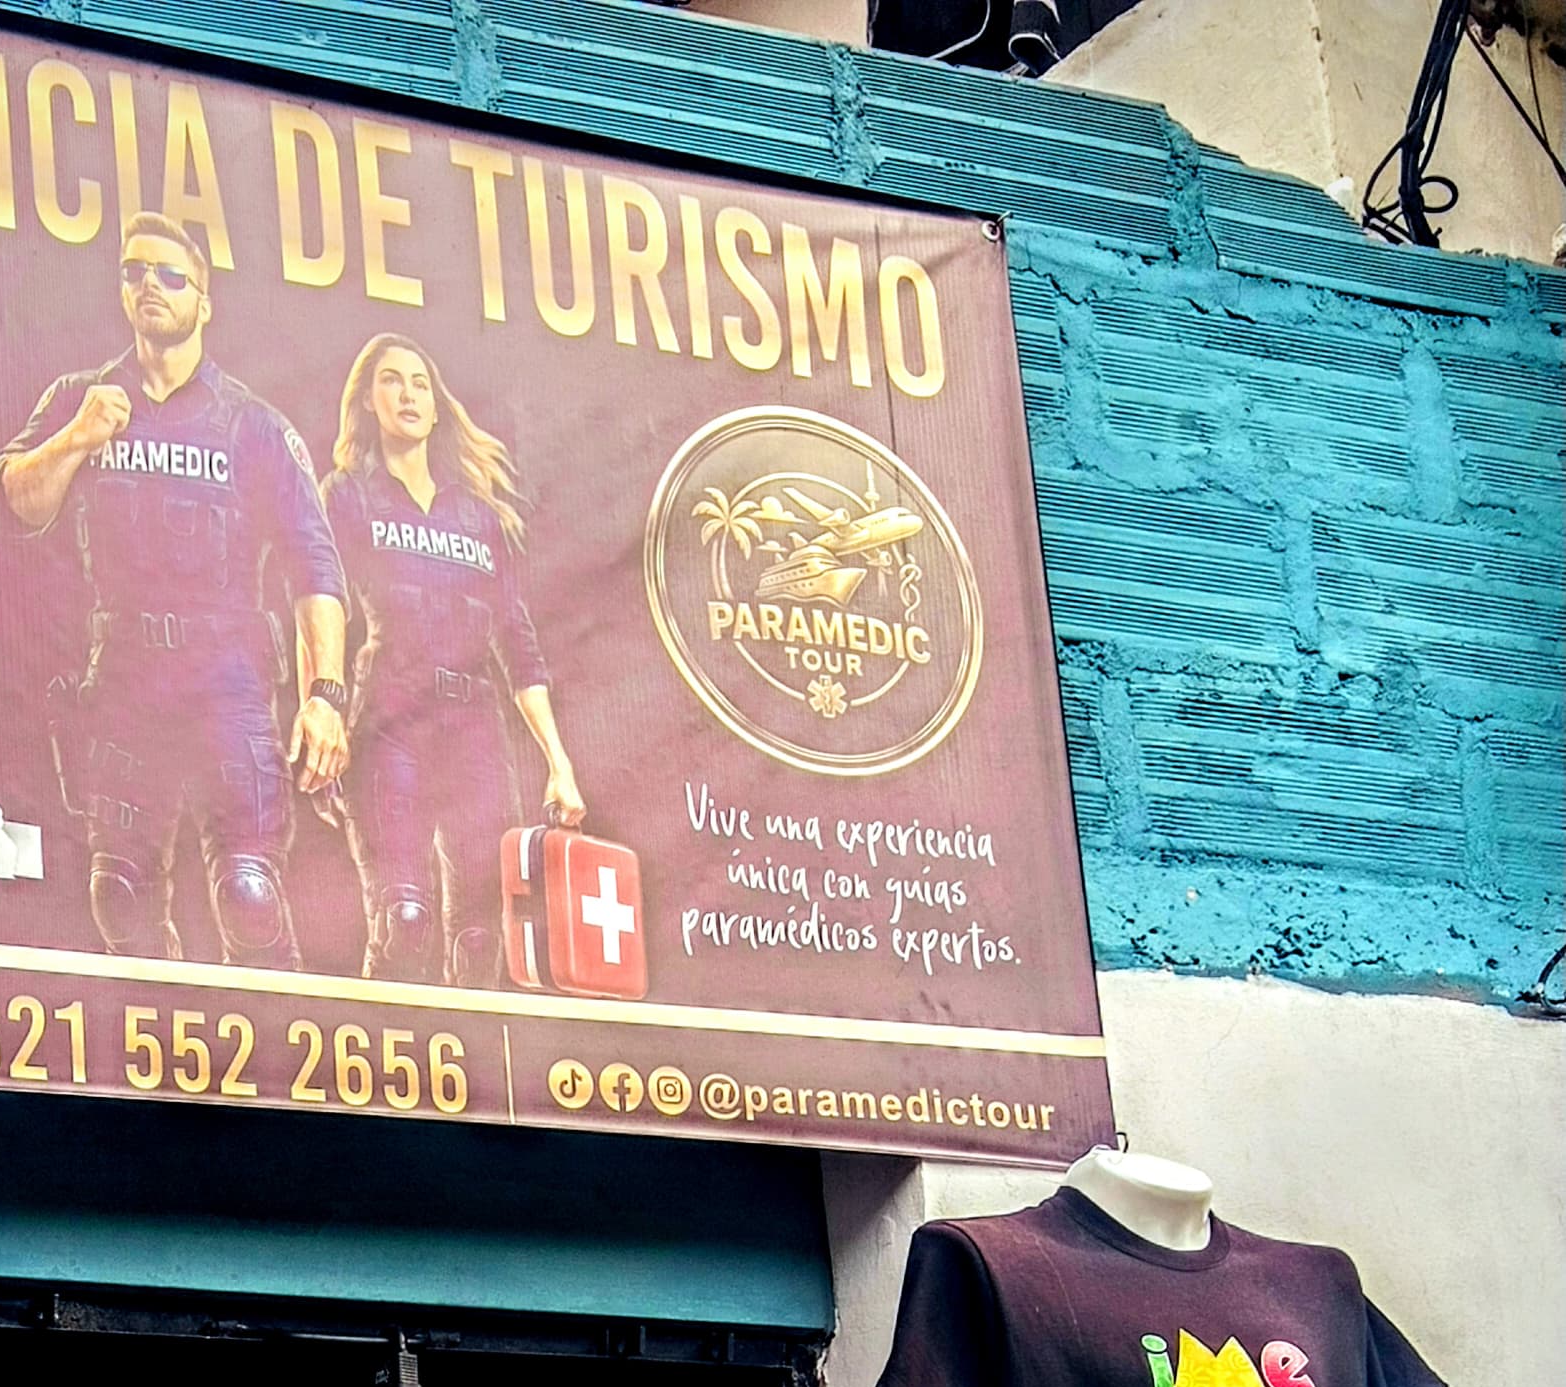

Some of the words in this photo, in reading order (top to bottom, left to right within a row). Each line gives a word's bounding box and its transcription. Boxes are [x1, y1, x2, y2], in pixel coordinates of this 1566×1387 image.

[270, 99, 425, 306] DE
[448, 137, 947, 399] TURISMO
[90, 440, 229, 483] ARAMEDIC
[371, 520, 494, 571] PARAMEDIC
[707, 601, 931, 664] PARAMEDIC
[784, 646, 863, 676] TOUR
[685, 781, 754, 841] Vive
[766, 814, 823, 850] una
[837, 819, 996, 866] experiencia
[727, 848, 809, 901] única
[824, 868, 871, 900] con
[886, 866, 967, 924] guías
[681, 902, 877, 956] paramédicos
[892, 920, 1022, 976] expertos.
[124, 1005, 258, 1096] 552
[287, 1019, 468, 1114] 2656
[699, 1072, 1056, 1132] @paramedictour
